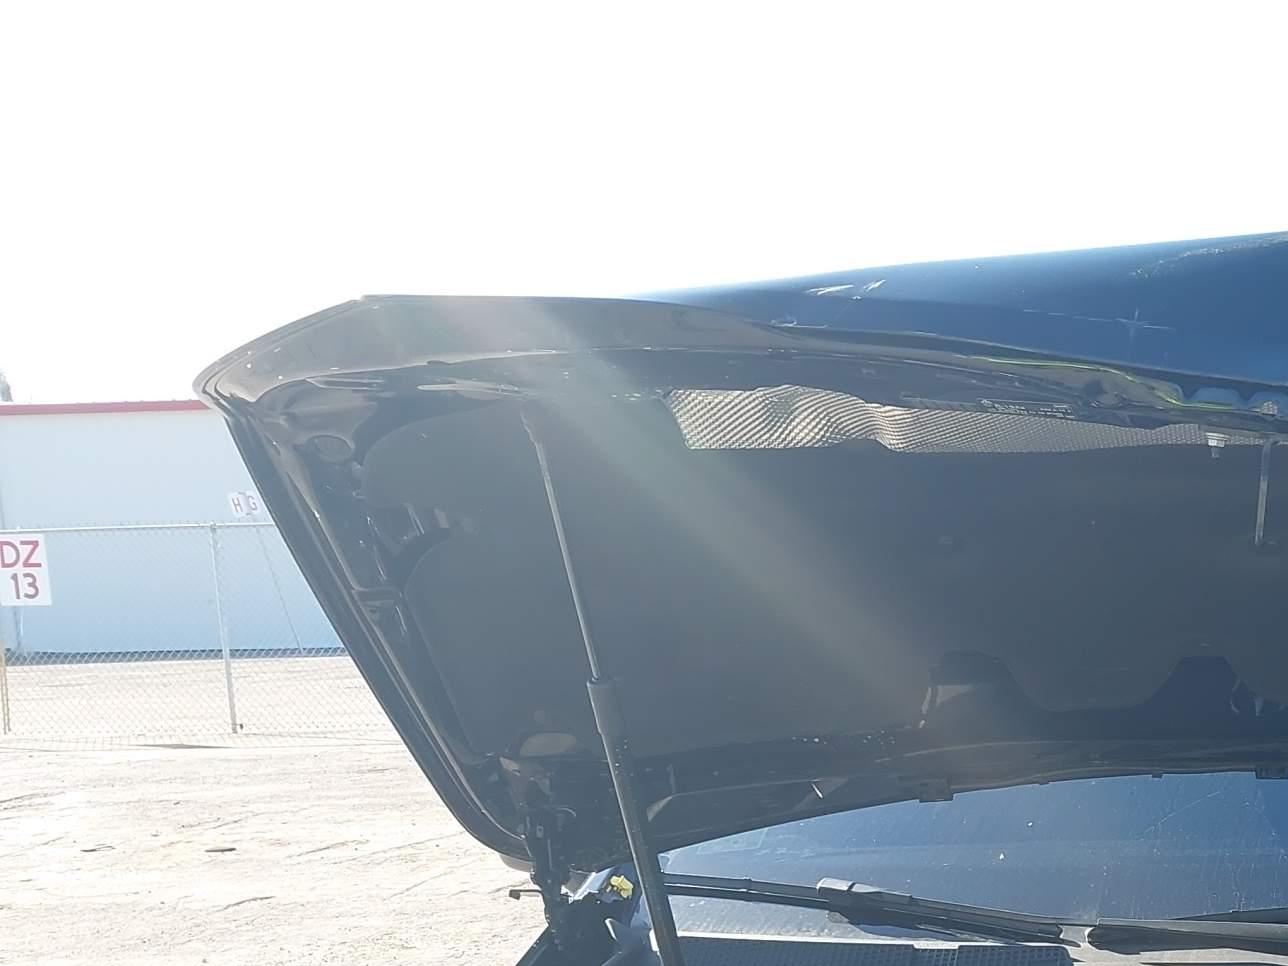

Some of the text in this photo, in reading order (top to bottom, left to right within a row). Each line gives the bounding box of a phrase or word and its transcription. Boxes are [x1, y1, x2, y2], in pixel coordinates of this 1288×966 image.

[231, 496, 244, 513] H
[0, 540, 42, 568] DZ
[10, 572, 40, 600] 13
